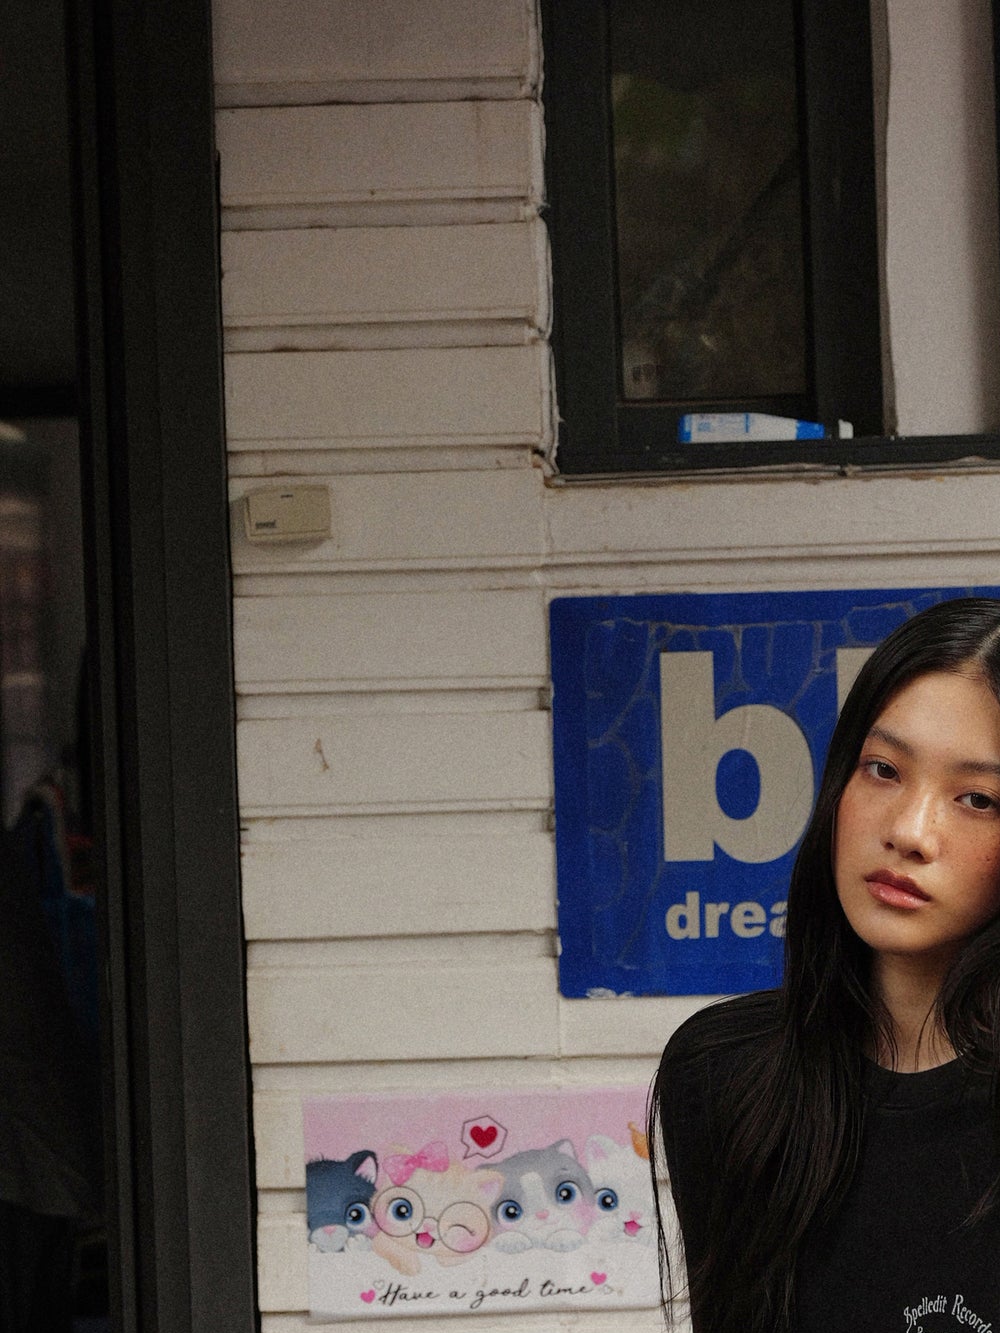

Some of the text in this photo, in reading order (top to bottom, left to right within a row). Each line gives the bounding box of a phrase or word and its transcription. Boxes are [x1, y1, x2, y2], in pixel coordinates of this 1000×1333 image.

[378, 1278, 594, 1309] Have a good time
